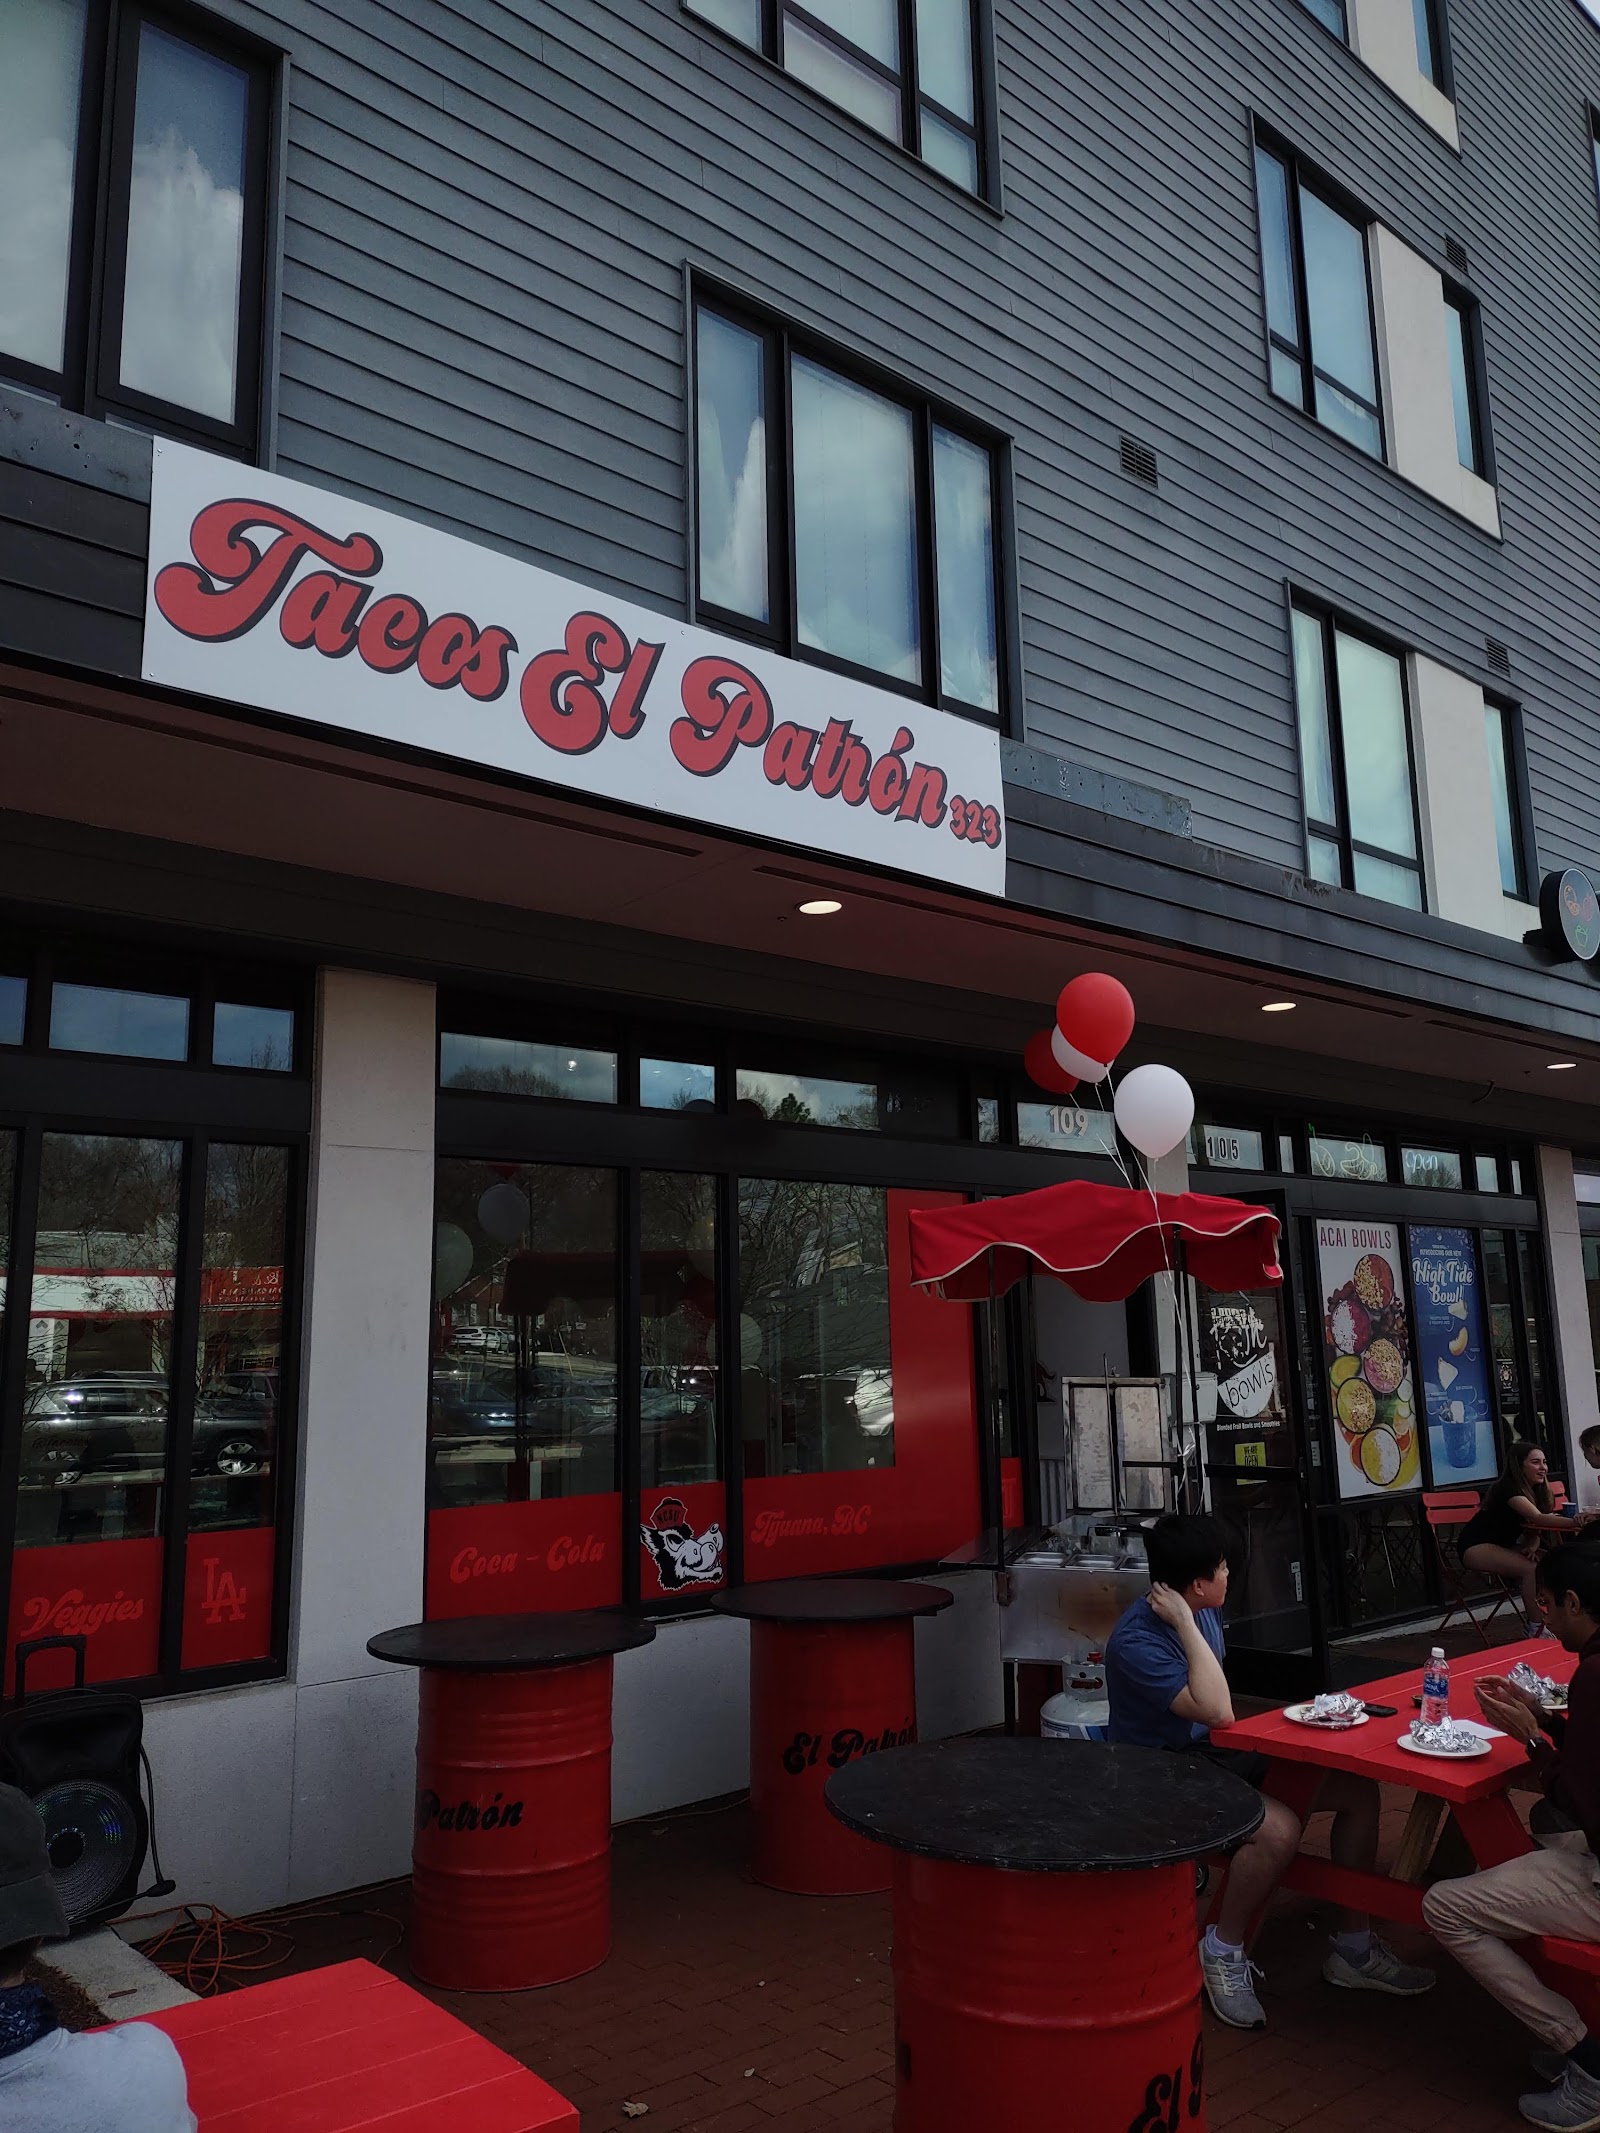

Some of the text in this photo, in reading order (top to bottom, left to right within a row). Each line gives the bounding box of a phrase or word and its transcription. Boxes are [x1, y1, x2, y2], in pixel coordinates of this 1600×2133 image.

[154, 498, 1002, 848] Tacos El Patrón 323
[1048, 1104, 1089, 1138] 109
[1206, 1135, 1239, 1161] 105
[1320, 1226, 1392, 1250] ACAI BOWLS
[1412, 1258, 1474, 1287] High Tide
[1225, 1360, 1274, 1408] bowls
[1216, 1423, 1233, 1432] Blended
[656, 1509, 680, 1525] NCSU
[831, 1504, 873, 1536] BC
[449, 1545, 518, 1584] Coca
[546, 1534, 607, 1572] Cola
[201, 1557, 248, 1625] LA
[19, 1588, 145, 1637] Veggies
[782, 1731, 823, 1775] El
